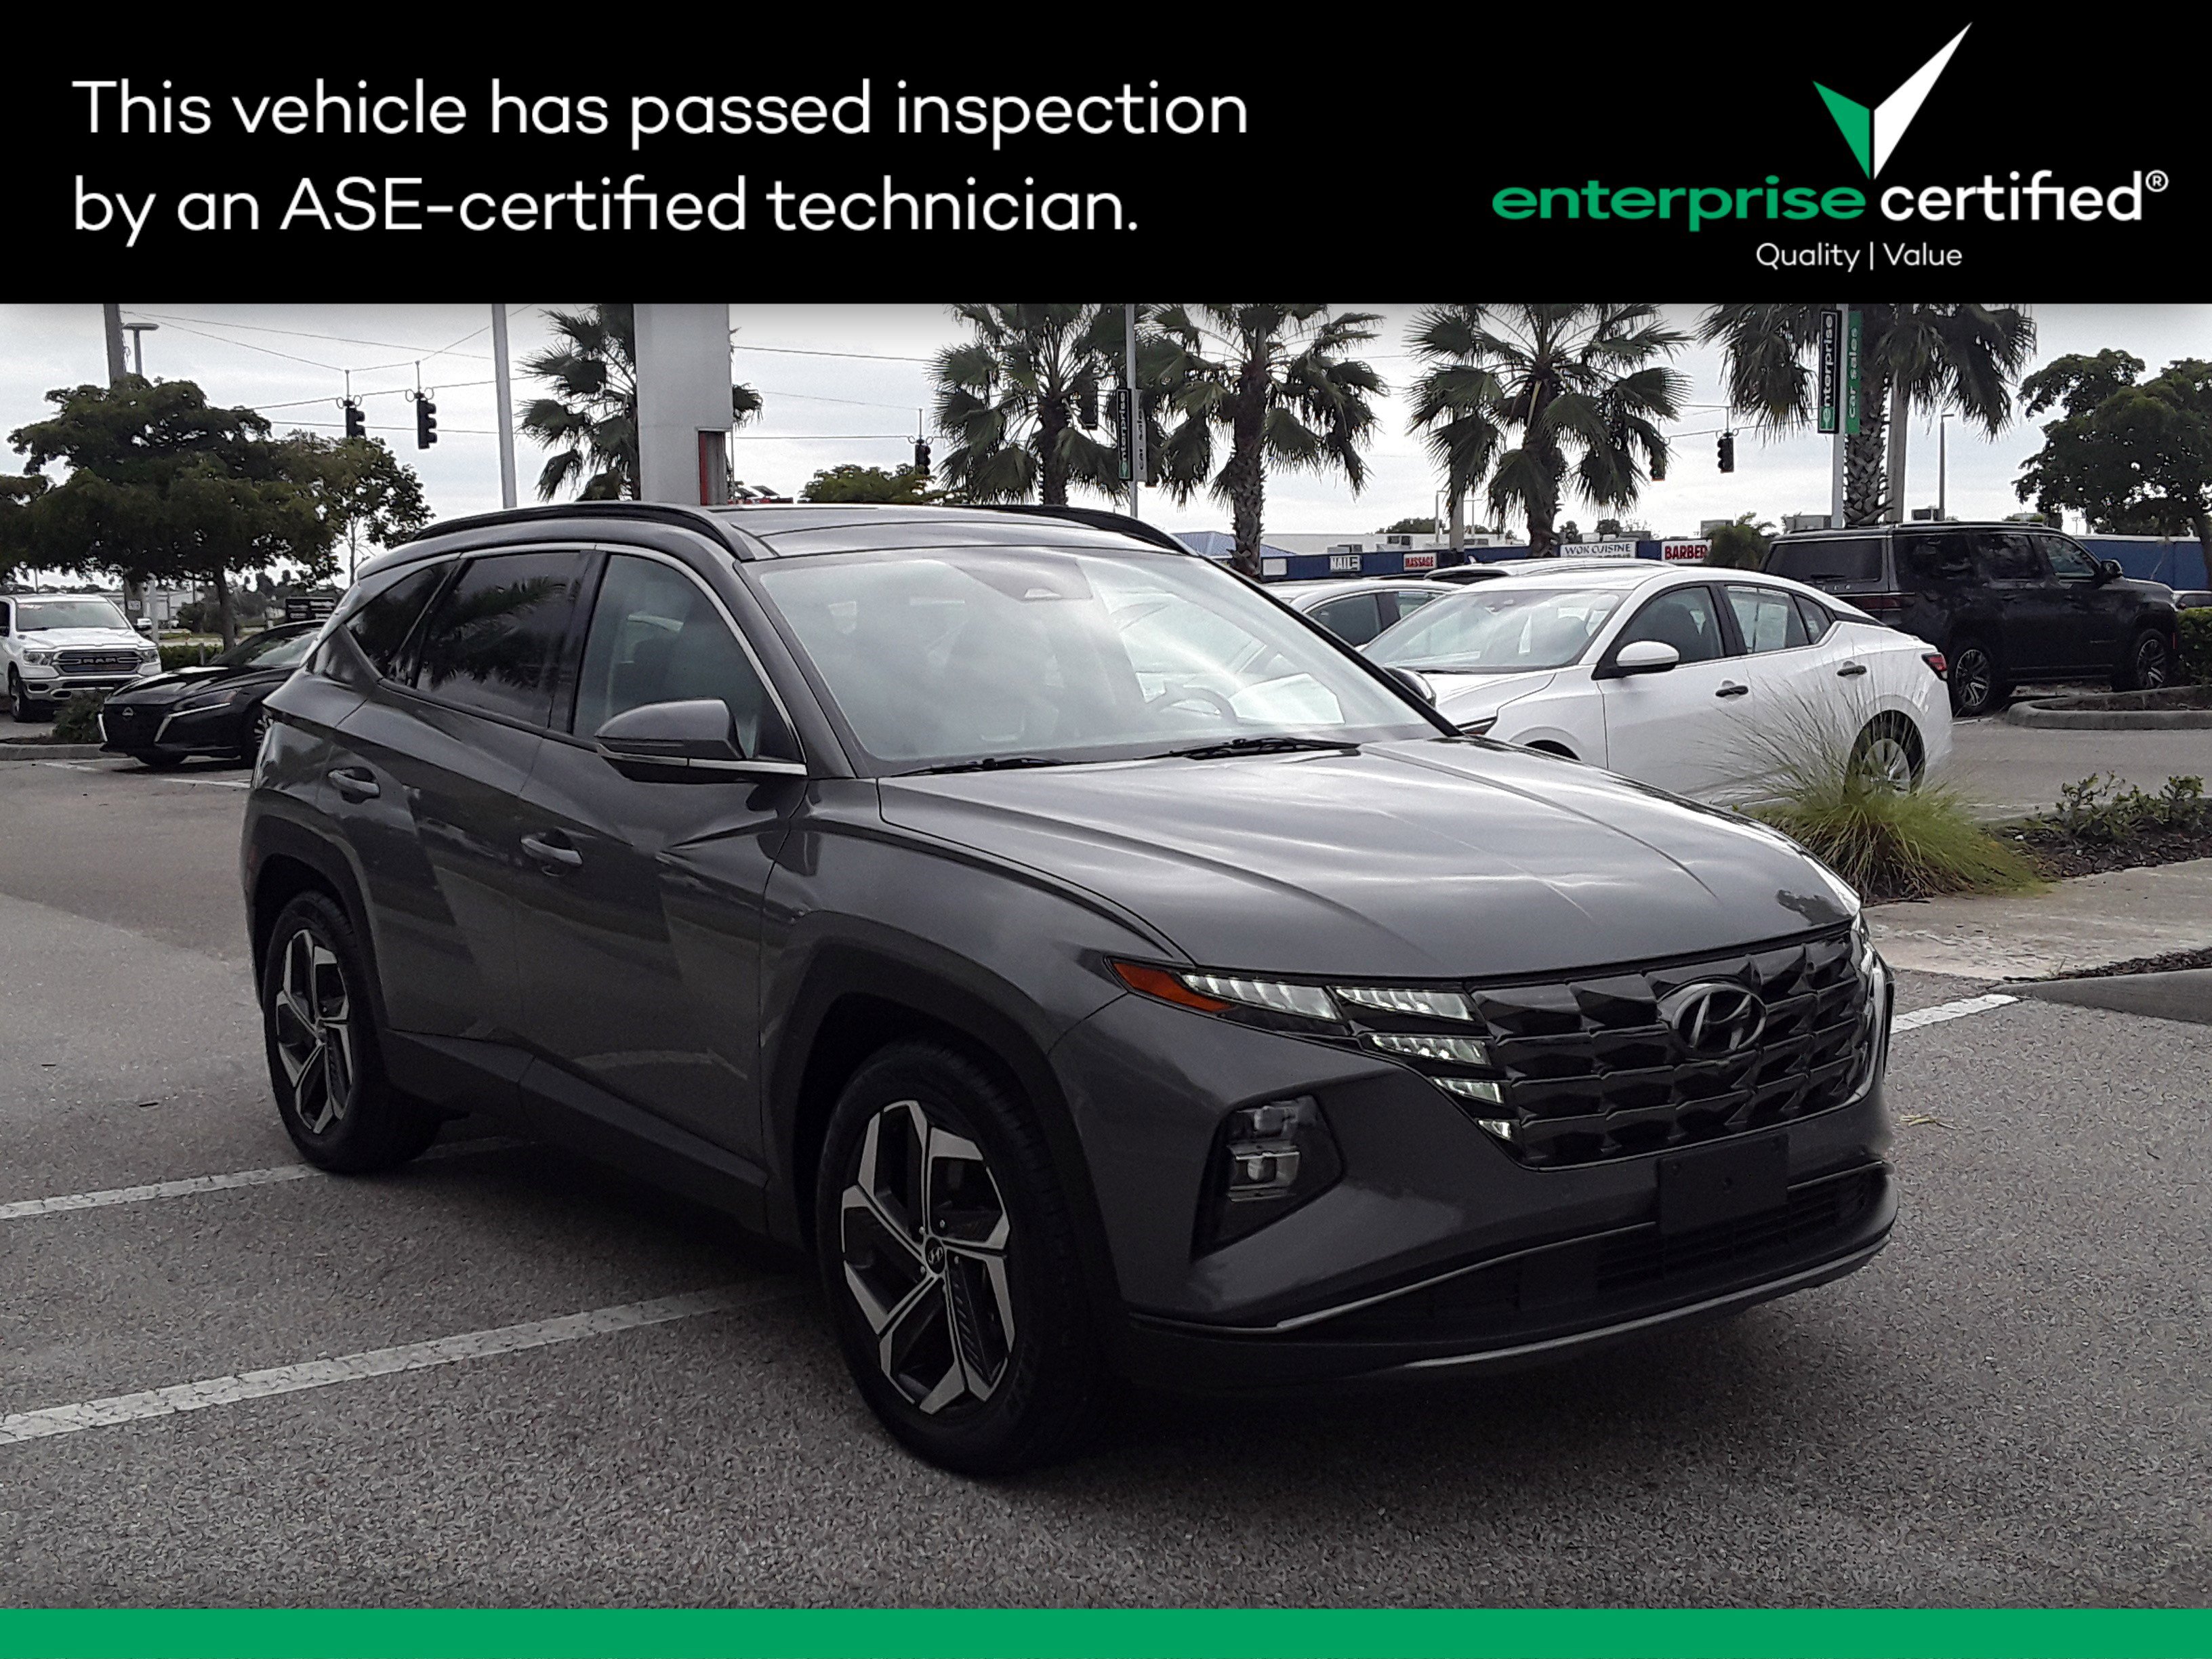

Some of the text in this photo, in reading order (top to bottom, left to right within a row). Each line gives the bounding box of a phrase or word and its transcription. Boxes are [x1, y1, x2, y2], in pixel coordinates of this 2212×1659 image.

[1849, 327, 1858, 418] car sales
[1565, 544, 1631, 555] WOK CUISINE
[1664, 545, 1708, 560] BARBER
